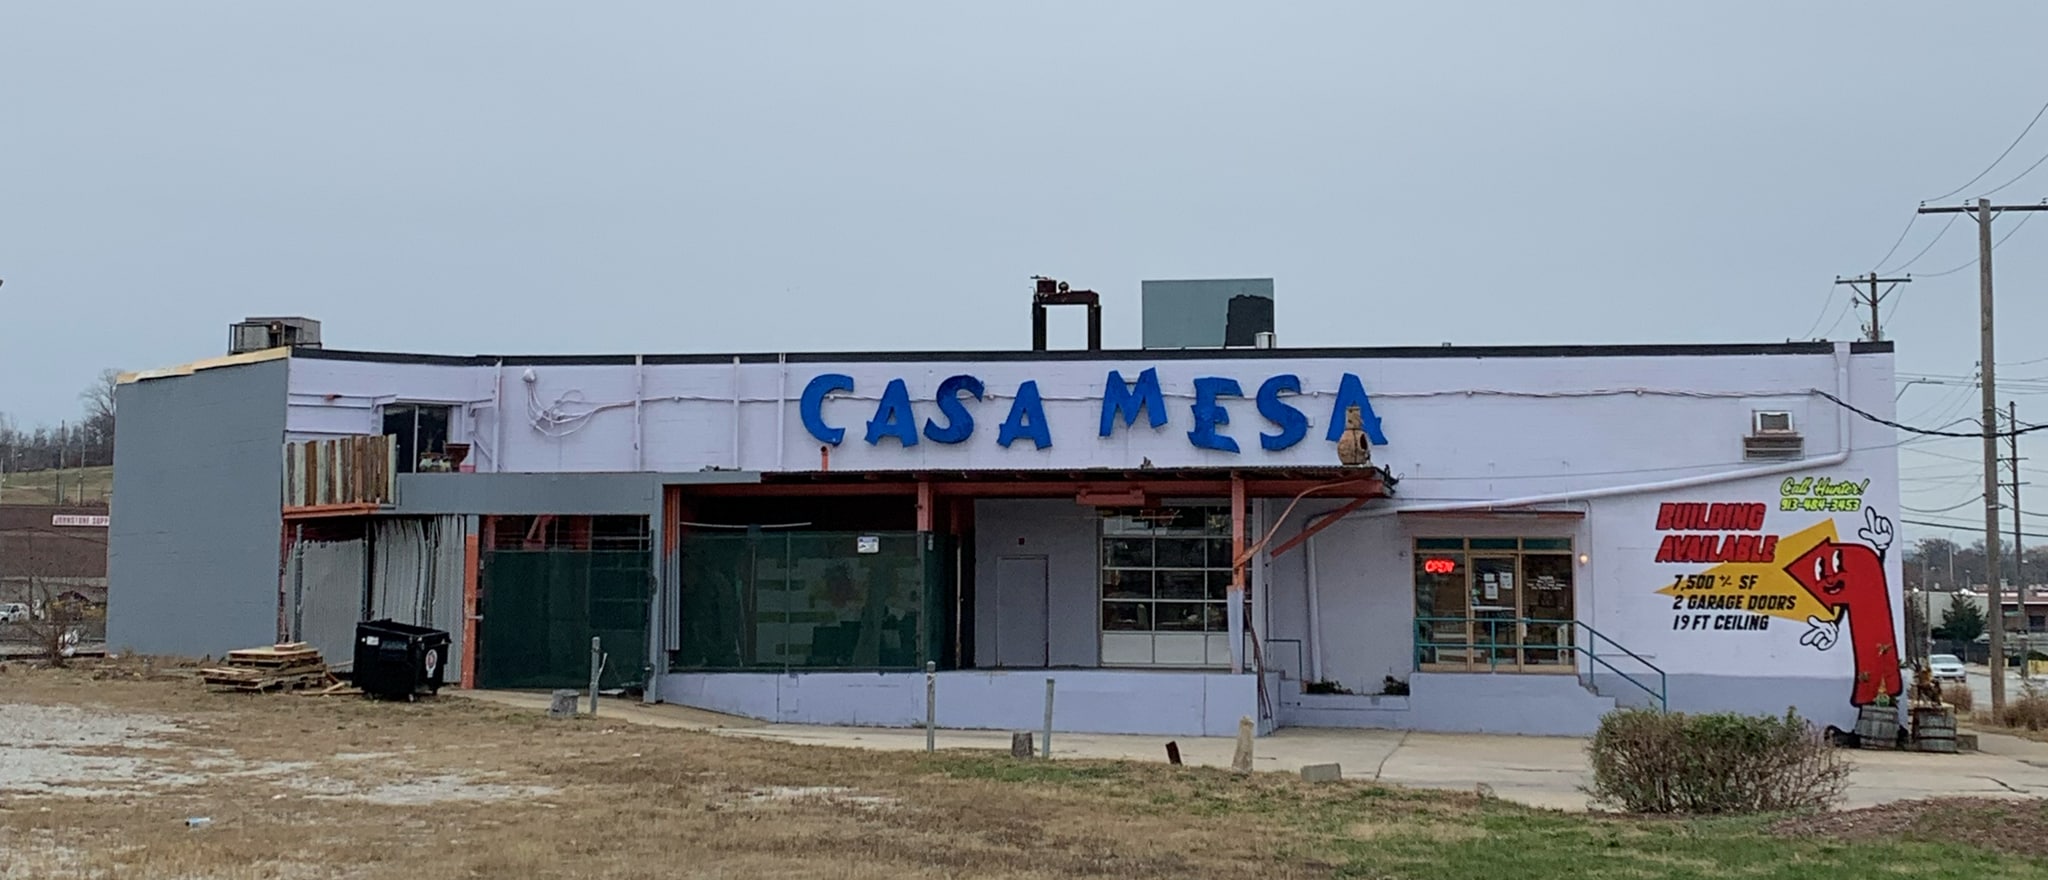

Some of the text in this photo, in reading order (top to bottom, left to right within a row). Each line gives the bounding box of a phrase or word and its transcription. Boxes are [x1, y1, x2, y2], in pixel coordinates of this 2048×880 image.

[799, 366, 1389, 455] CASA MESA
[1780, 476, 1870, 496] Call Hunter!
[1780, 498, 1861, 511] 913-484-3453
[1655, 502, 1767, 531] BUILDING
[1655, 535, 1779, 563] AVAILABLE
[1425, 559, 1455, 573] OPEN
[1672, 574, 1715, 590] 7,500
[1739, 575, 1758, 590] SF
[1672, 594, 1797, 610] 2 GARAGE DOORS
[1672, 615, 1769, 630] 19 FT CEILING
